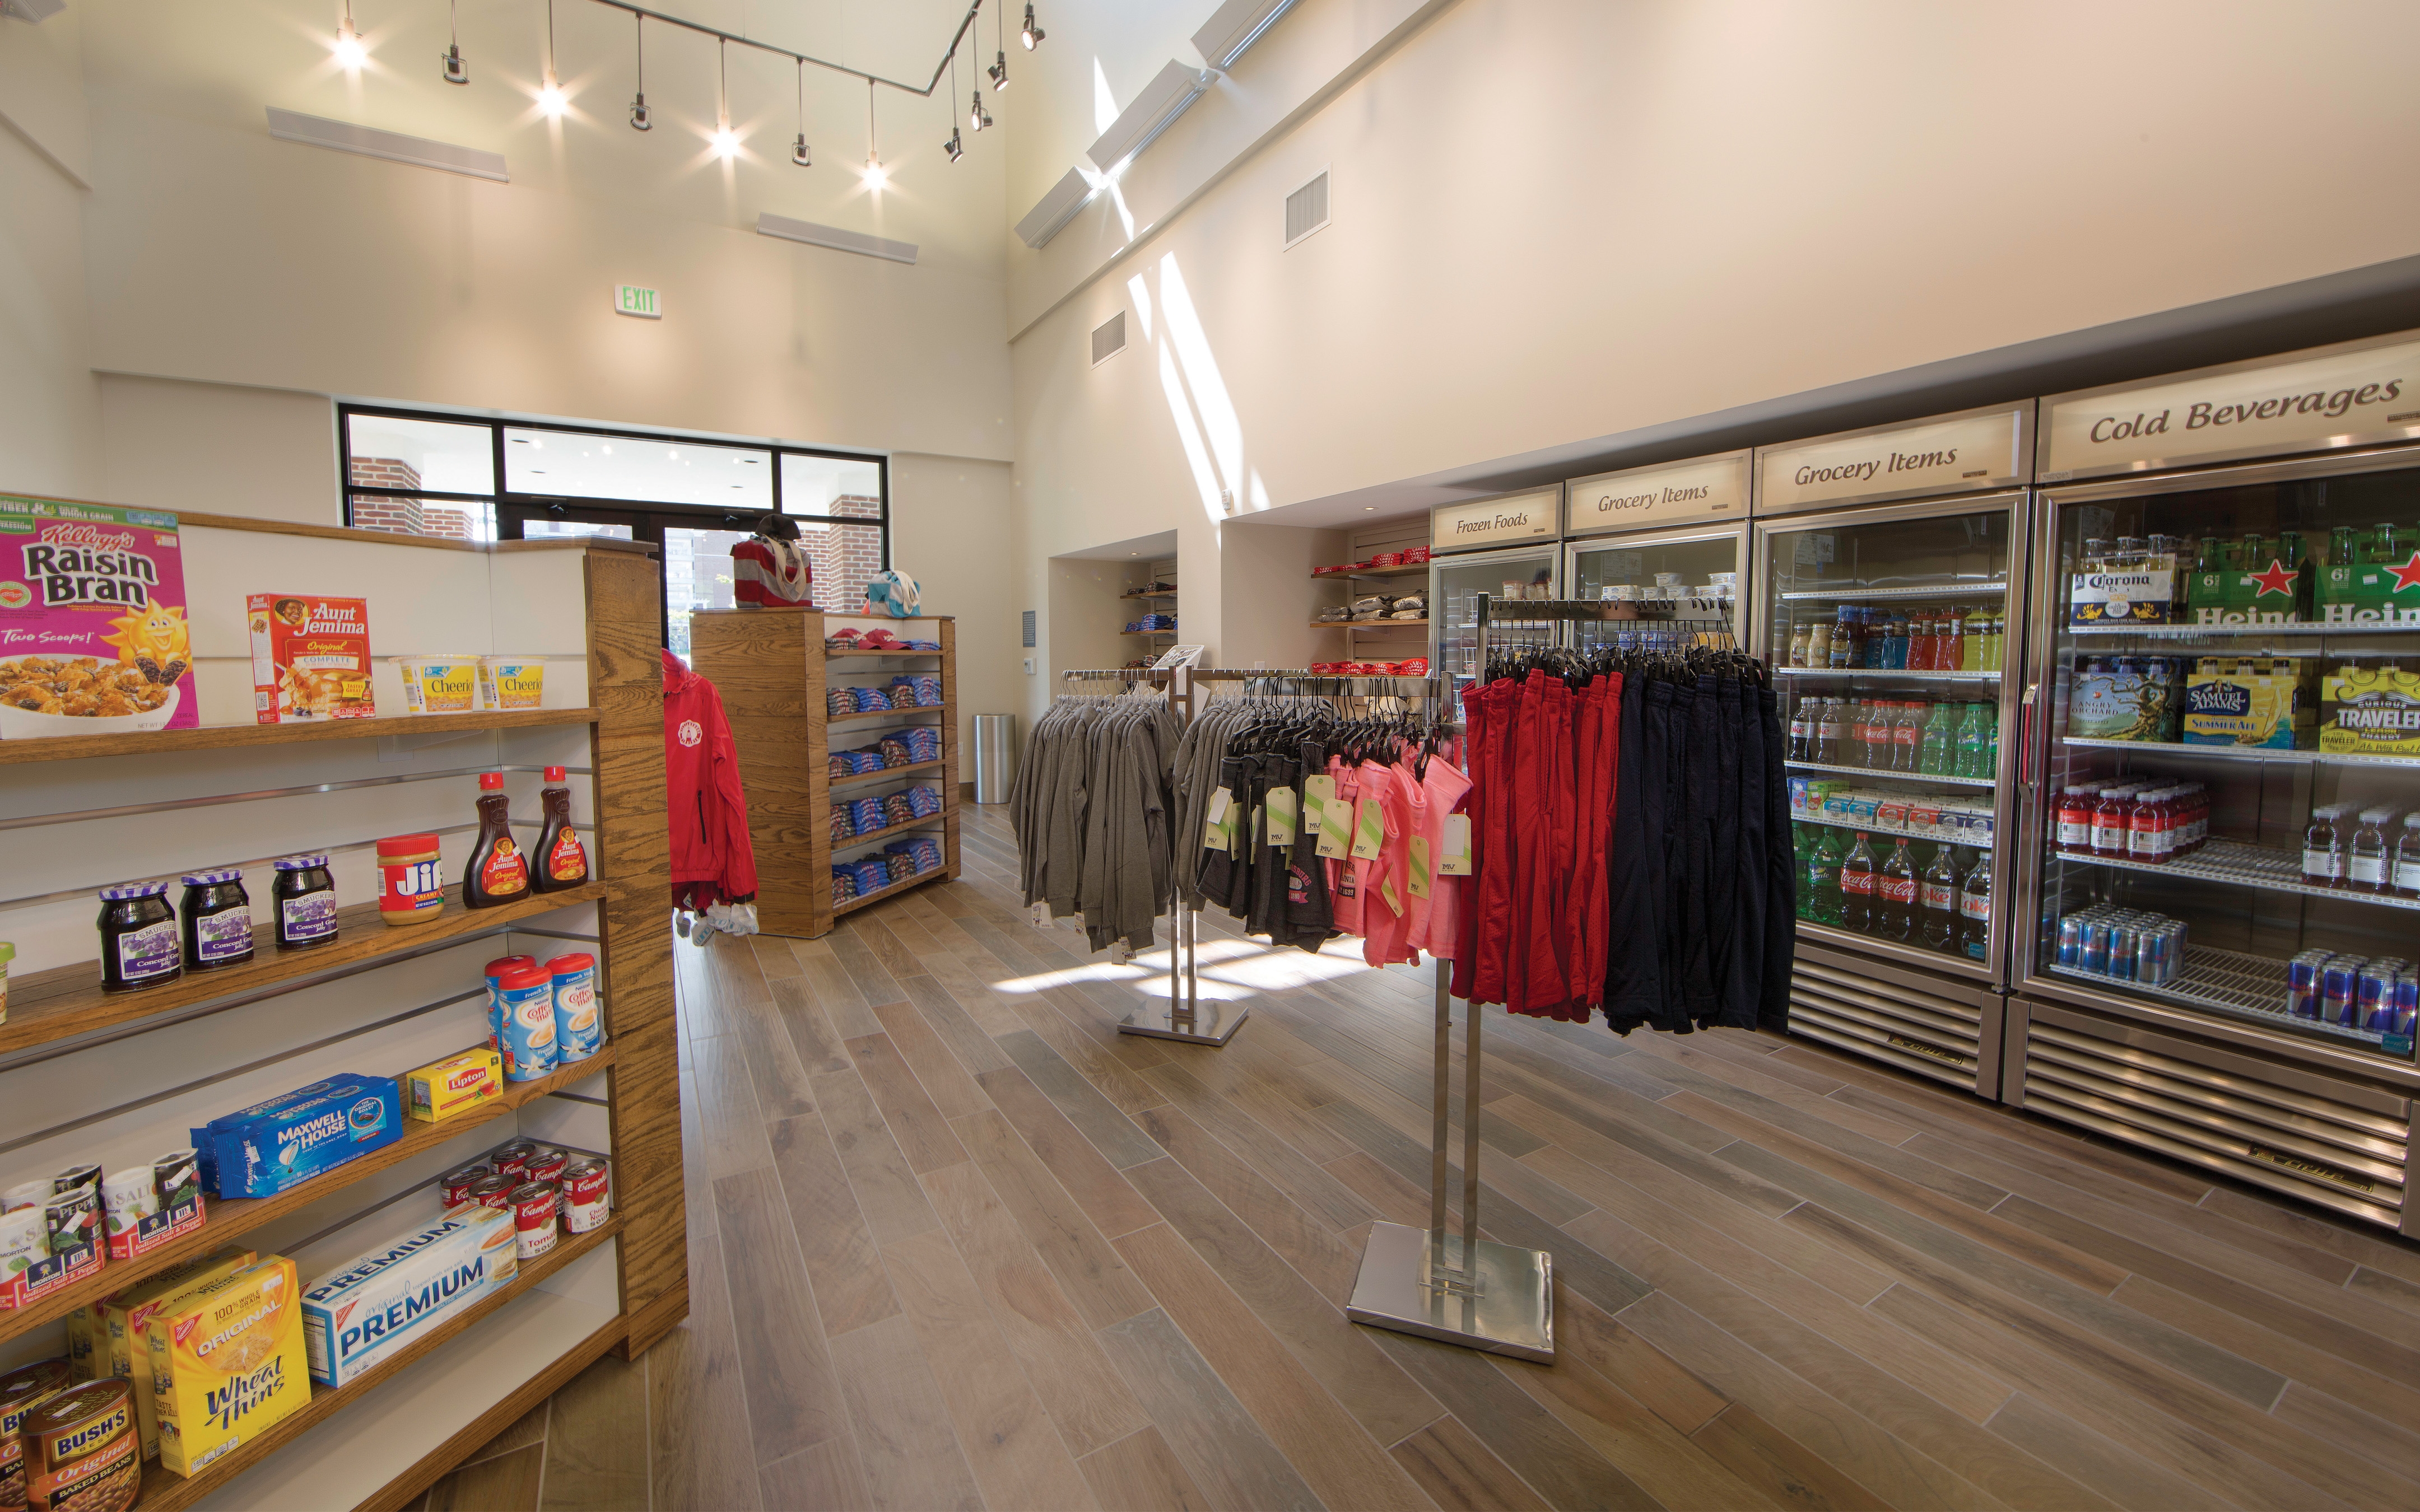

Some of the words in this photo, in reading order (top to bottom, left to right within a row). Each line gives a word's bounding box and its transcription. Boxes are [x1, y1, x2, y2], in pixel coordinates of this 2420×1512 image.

[622, 286, 655, 312] EXIT
[2089, 408, 2170, 444] Cold
[2185, 377, 2403, 431] Beverages
[1795, 460, 1881, 486] Grocery
[1887, 448, 1958, 473] Items
[1598, 491, 1657, 512] Grocery
[1662, 484, 1709, 505] Items
[1456, 518, 1491, 534] Frozen
[1494, 512, 1528, 529] Foods
[43, 524, 134, 551] Kellogg's
[27, 545, 155, 582] Raisin
[2089, 574, 2150, 590] Corona
[2203, 575, 2214, 587] 6
[2331, 568, 2343, 582] 6
[46, 574, 146, 606] Bran
[249, 602, 268, 610] Jemima
[314, 603, 356, 620] Aunt
[294, 617, 365, 636] Jemima
[1, 629, 35, 644] Two
[39, 631, 91, 644] Scoops!
[307, 641, 347, 655] Original
[2190, 690, 2246, 703] SAMUEL
[2072, 707, 2119, 716] ORCHARD
[2077, 701, 2112, 709] ANGRY
[2193, 699, 2241, 711] ADAMS
[2358, 701, 2408, 710] CURIOUS
[2191, 718, 2236, 730] SUMMER
[2237, 720, 2257, 731] ALE
[2321, 736, 2356, 745] TRAVELER
[2359, 743, 2373, 752] Ale
[2376, 744, 2393, 752] With
[2395, 743, 2414, 752] Real
[555, 848, 579, 859] Jemima
[562, 842, 576, 851] Aunt
[497, 854, 514, 863] Aunt
[560, 855, 580, 867] Original
[489, 860, 518, 872] Jemima
[395, 860, 443, 897] Jif
[495, 868, 519, 881] Original
[1811, 871, 1831, 882] Sprite
[298, 894, 334, 906] SMUCKER'S
[416, 892, 437, 900] CREAMY
[1920, 890, 1950, 903] oke
[215, 908, 250, 923] SMUCKER
[139, 925, 176, 939] SMUCKER
[296, 921, 324, 930] Concord
[213, 940, 243, 949] Concord
[137, 955, 168, 967] Concord
[566, 974, 583, 983] French
[525, 988, 542, 998] French
[569, 988, 592, 1004] Coffee
[578, 992, 594, 1007] mate
[527, 1002, 551, 1018] Coffee
[537, 1009, 552, 1023] mate
[451, 1070, 485, 1089] Lipton
[354, 1100, 377, 1112] ORIGINAL
[277, 1110, 346, 1145] MAXWELL
[301, 1119, 346, 1149] HOUSE
[361, 1132, 377, 1141] MEDIUM
[115, 1182, 151, 1205] SALT
[59, 1196, 96, 1219] PEPPE
[589, 1203, 608, 1216] Chicken
[590, 1214, 609, 1227] SOUP
[135, 1234, 160, 1250] Iodized
[161, 1229, 174, 1240] Salt
[182, 1216, 203, 1231] Pepper
[142, 1225, 168, 1240] MORTON
[0, 1245, 31, 1258] MORTON
[534, 1239, 556, 1254] SOUP
[305, 1221, 461, 1302] PREMIUM
[22, 1282, 52, 1300] Iodized
[53, 1275, 68, 1287] Salt
[77, 1261, 101, 1277] Pepper
[31, 1271, 61, 1288] MORTON
[239, 1295, 261, 1309] GRAIN
[365, 1280, 411, 1318] original
[436, 1296, 456, 1310] SALTINE
[456, 1281, 481, 1299] CRACKERS
[214, 1301, 238, 1321] 100%
[239, 1289, 260, 1303] WHOLE
[341, 1255, 483, 1358] PREMIUM
[197, 1299, 283, 1357] ORIGINAL
[150, 1334, 165, 1346] Wheat
[150, 1344, 166, 1354] Thins
[204, 1354, 286, 1415] Wheat
[156, 1399, 172, 1411] TASTE
[204, 1375, 285, 1430] Thins
[57, 1409, 125, 1457] BUSH'S
[79, 1434, 110, 1452] BEST
[56, 1435, 130, 1482] Original
[192, 1458, 202, 1467] 140
[59, 1474, 99, 1499] BAKED
[99, 1455, 132, 1478] BEANS
